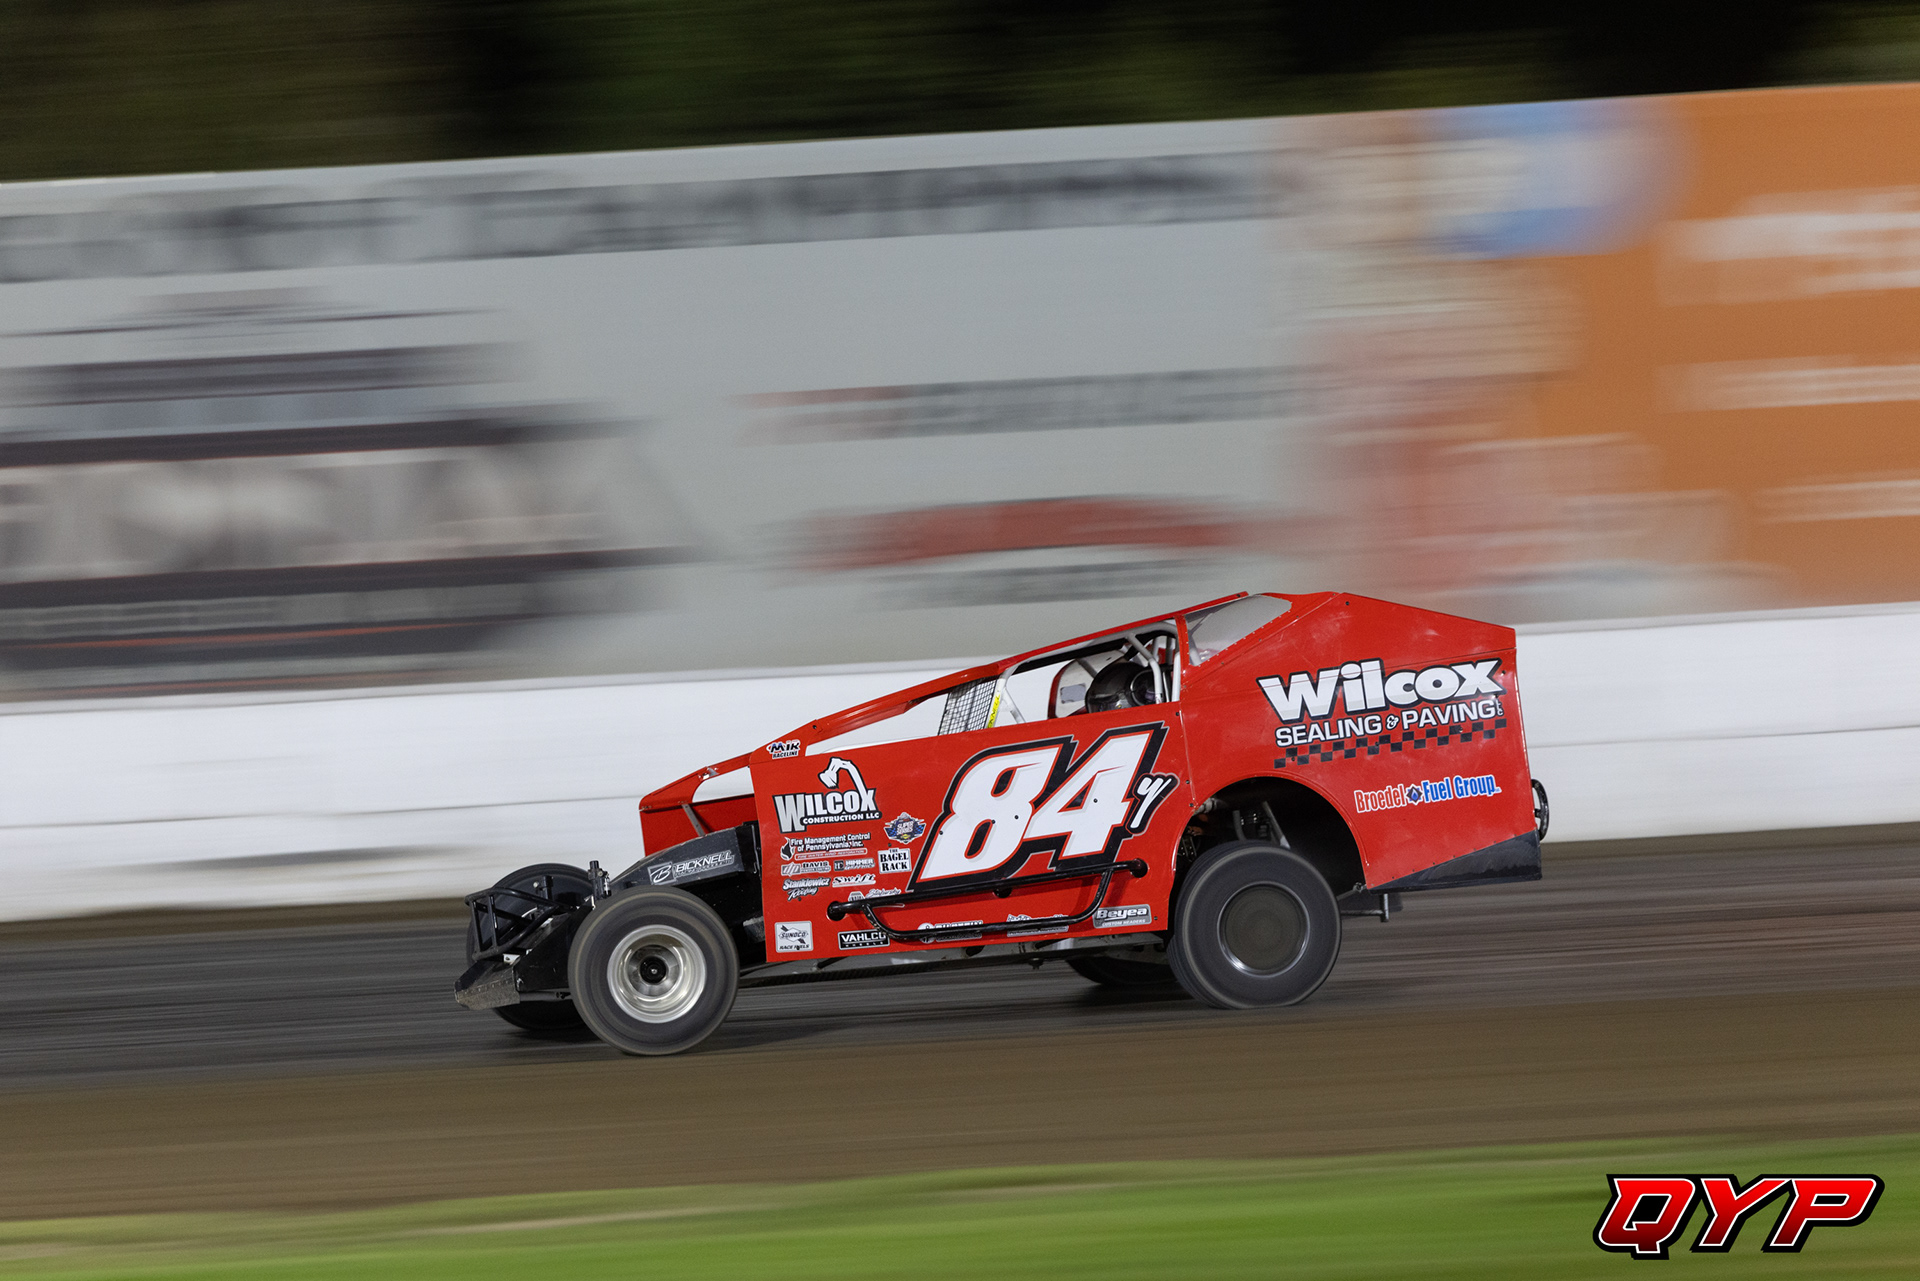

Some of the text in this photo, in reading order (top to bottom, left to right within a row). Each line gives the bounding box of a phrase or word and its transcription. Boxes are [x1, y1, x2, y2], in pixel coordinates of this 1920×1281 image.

[1258, 660, 1504, 722] Wilcox
[1275, 715, 1382, 747] SEALING
[1385, 715, 1399, 729] &
[1402, 699, 1496, 730] PAVING
[772, 750, 798, 759] RACELINE
[1354, 775, 1496, 813] Broedel Fuel Group
[773, 788, 878, 833] WILCOX
[802, 812, 880, 825] CONSTRUCTION LLC
[790, 832, 871, 846] Fire Management Control
[805, 841, 851, 851] Pennsylvania,
[676, 852, 732, 873] BICKNELL
[880, 852, 909, 863] BAGEL
[803, 861, 828, 869] DAVIS
[881, 861, 908, 872] RACK
[782, 877, 830, 890] Stankiewicz
[832, 874, 874, 884] Swift
[1096, 907, 1148, 921] Beyea
[781, 931, 806, 939] SUNOCO
